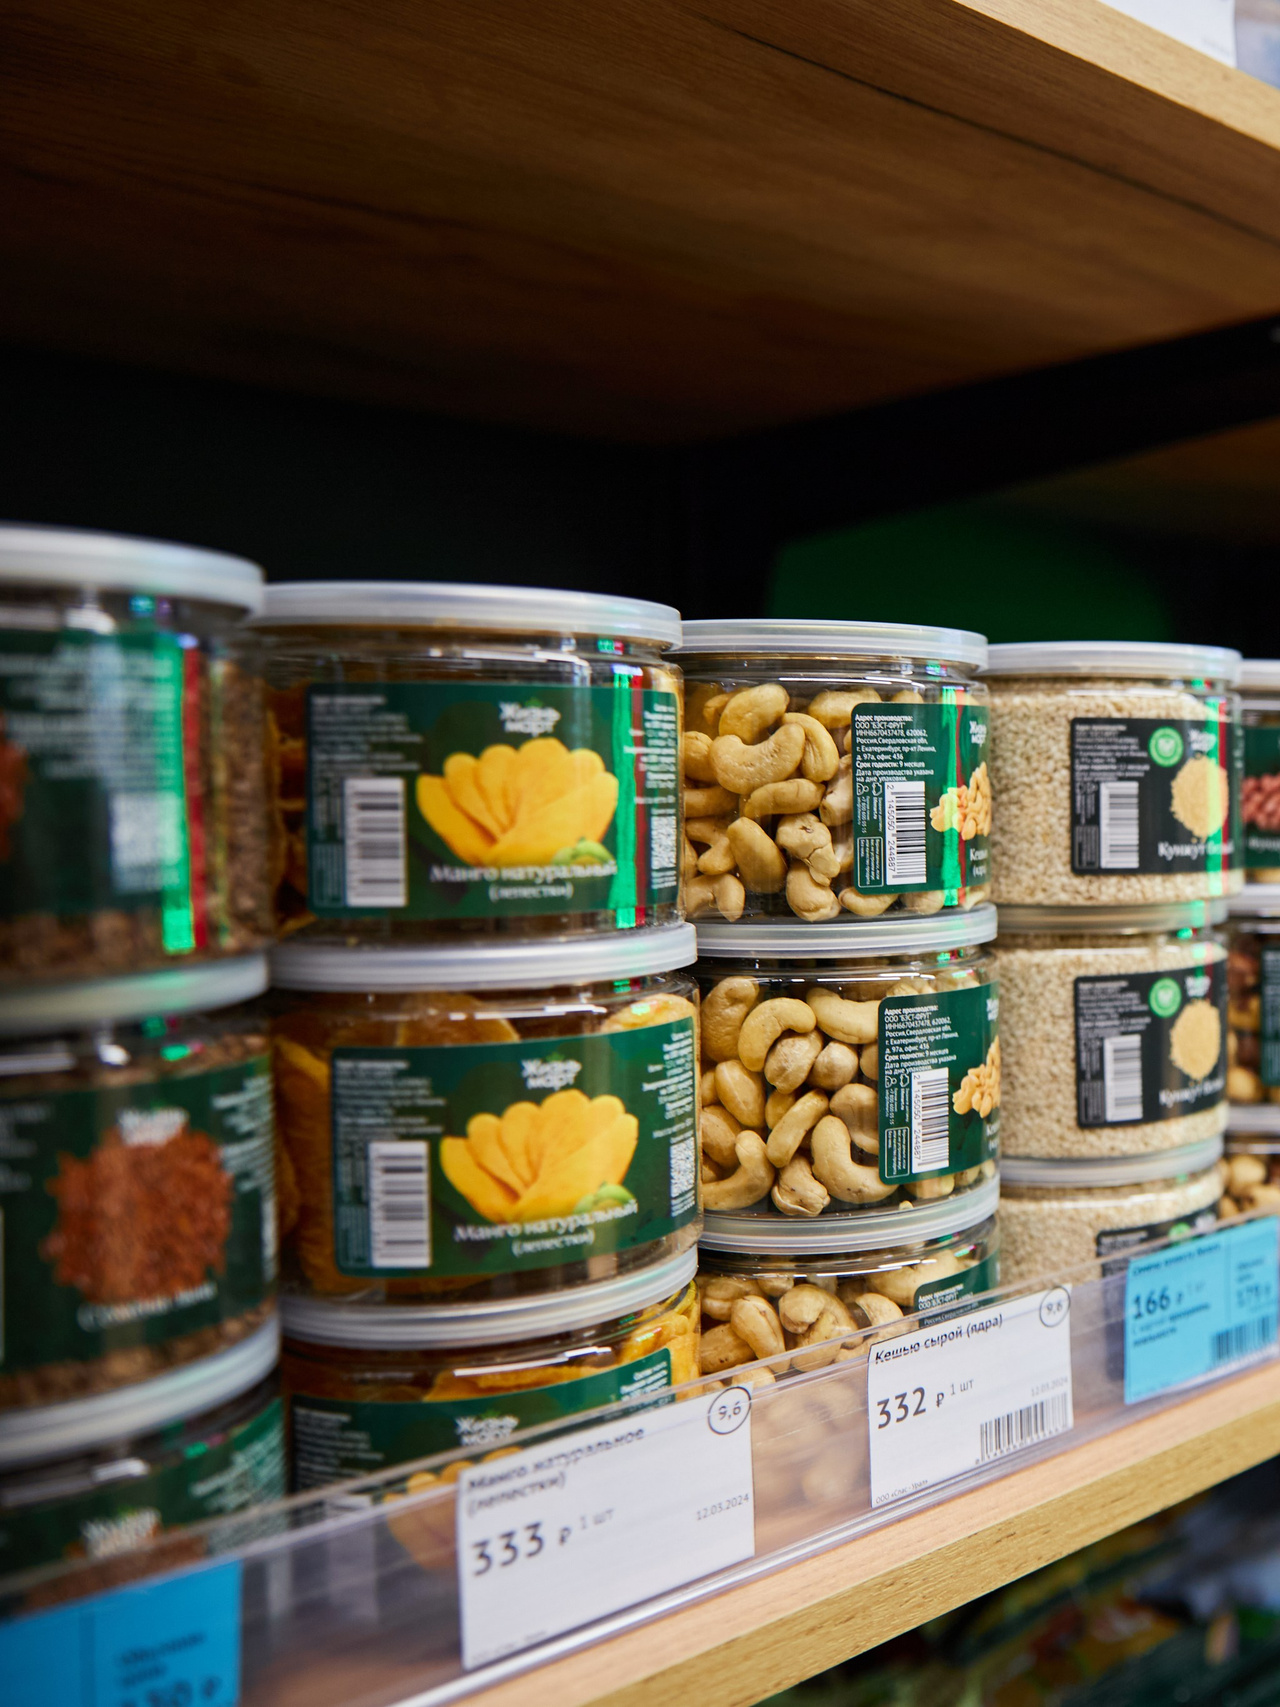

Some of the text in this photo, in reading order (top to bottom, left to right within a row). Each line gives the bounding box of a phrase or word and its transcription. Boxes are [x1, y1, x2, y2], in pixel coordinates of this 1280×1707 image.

[855, 714, 873, 722] Адрес
[855, 761, 871, 769] Срок
[855, 769, 871, 777] Дата
[872, 769, 913, 777] производства
[429, 864, 499, 883] Манго
[884, 1008, 902, 1016] Адрес
[884, 1054, 899, 1062] Срок
[884, 1062, 900, 1070] Дата
[900, 1057, 938, 1068] производства
[454, 1198, 638, 1243] Манго натуральный
[1045, 1300, 1064, 1315] 9,6
[1133, 1286, 1170, 1320] 166
[875, 1314, 1003, 1364] Кешью сырой (ядра)
[718, 1401, 742, 1421] 9,6
[877, 1387, 927, 1429] 332
[960, 1379, 974, 1393] шт
[532, 1428, 645, 1471] натуральное
[696, 1493, 750, 1521] 12.03.2024
[473, 1521, 545, 1577] 333
[592, 1508, 616, 1526] шт
